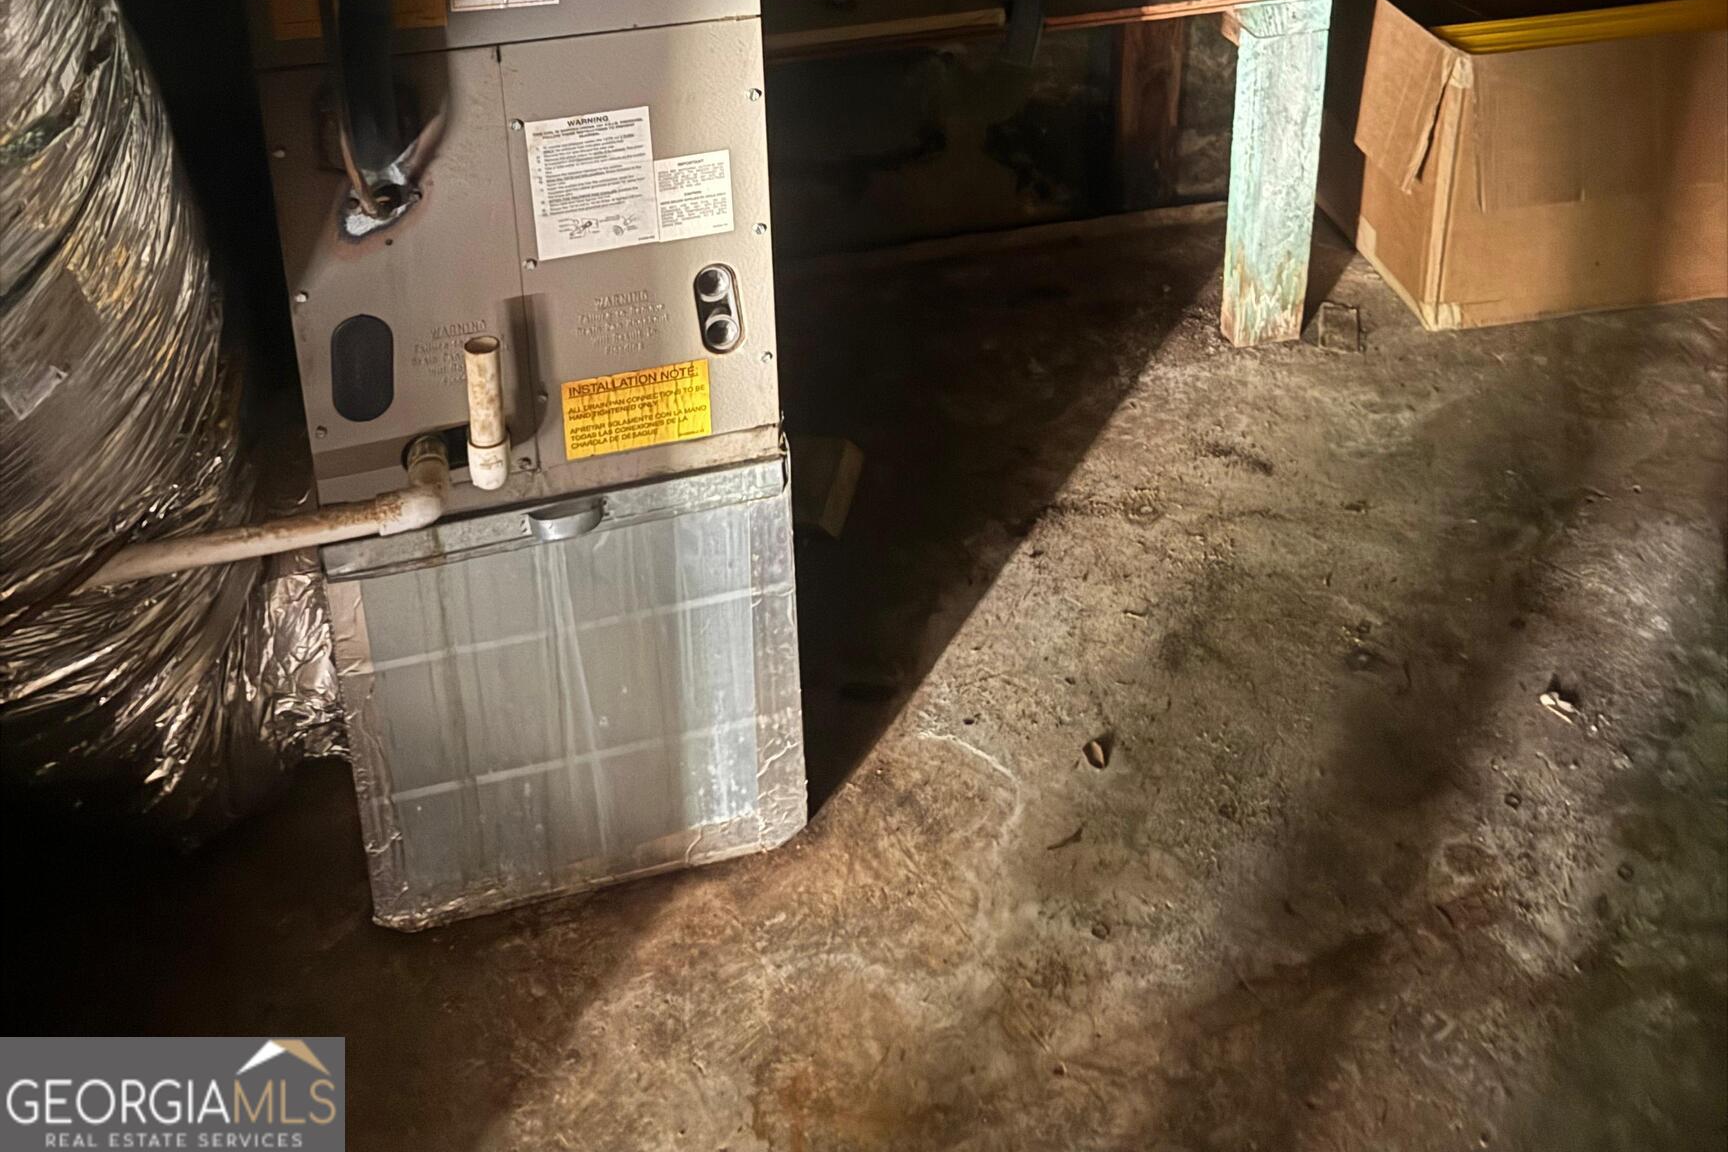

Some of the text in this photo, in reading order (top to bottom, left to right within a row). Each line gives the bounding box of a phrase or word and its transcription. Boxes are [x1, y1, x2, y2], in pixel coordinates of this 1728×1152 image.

[567, 115, 609, 127] WARNING
[594, 290, 648, 310] WARNING
[431, 319, 487, 339] WARNING
[568, 372, 657, 397] INSTALLATION
[568, 406, 581, 414] ALL
[583, 402, 608, 412] DRAIN
[609, 398, 625, 406] PAN
[626, 388, 682, 404] CONNECTIONS
[695, 384, 705, 392] BE
[568, 400, 658, 421] HAND TIGHTENED ONLY
[570, 423, 605, 435] APRETAR
[608, 414, 654, 428] SOLAMENTE
[655, 411, 672, 419] CON
[684, 404, 707, 414] MANO
[598, 429, 613, 437] LAS
[614, 419, 665, 434] CONEXIONES
[678, 415, 688, 423] LA
[609, 435, 620, 443] DE
